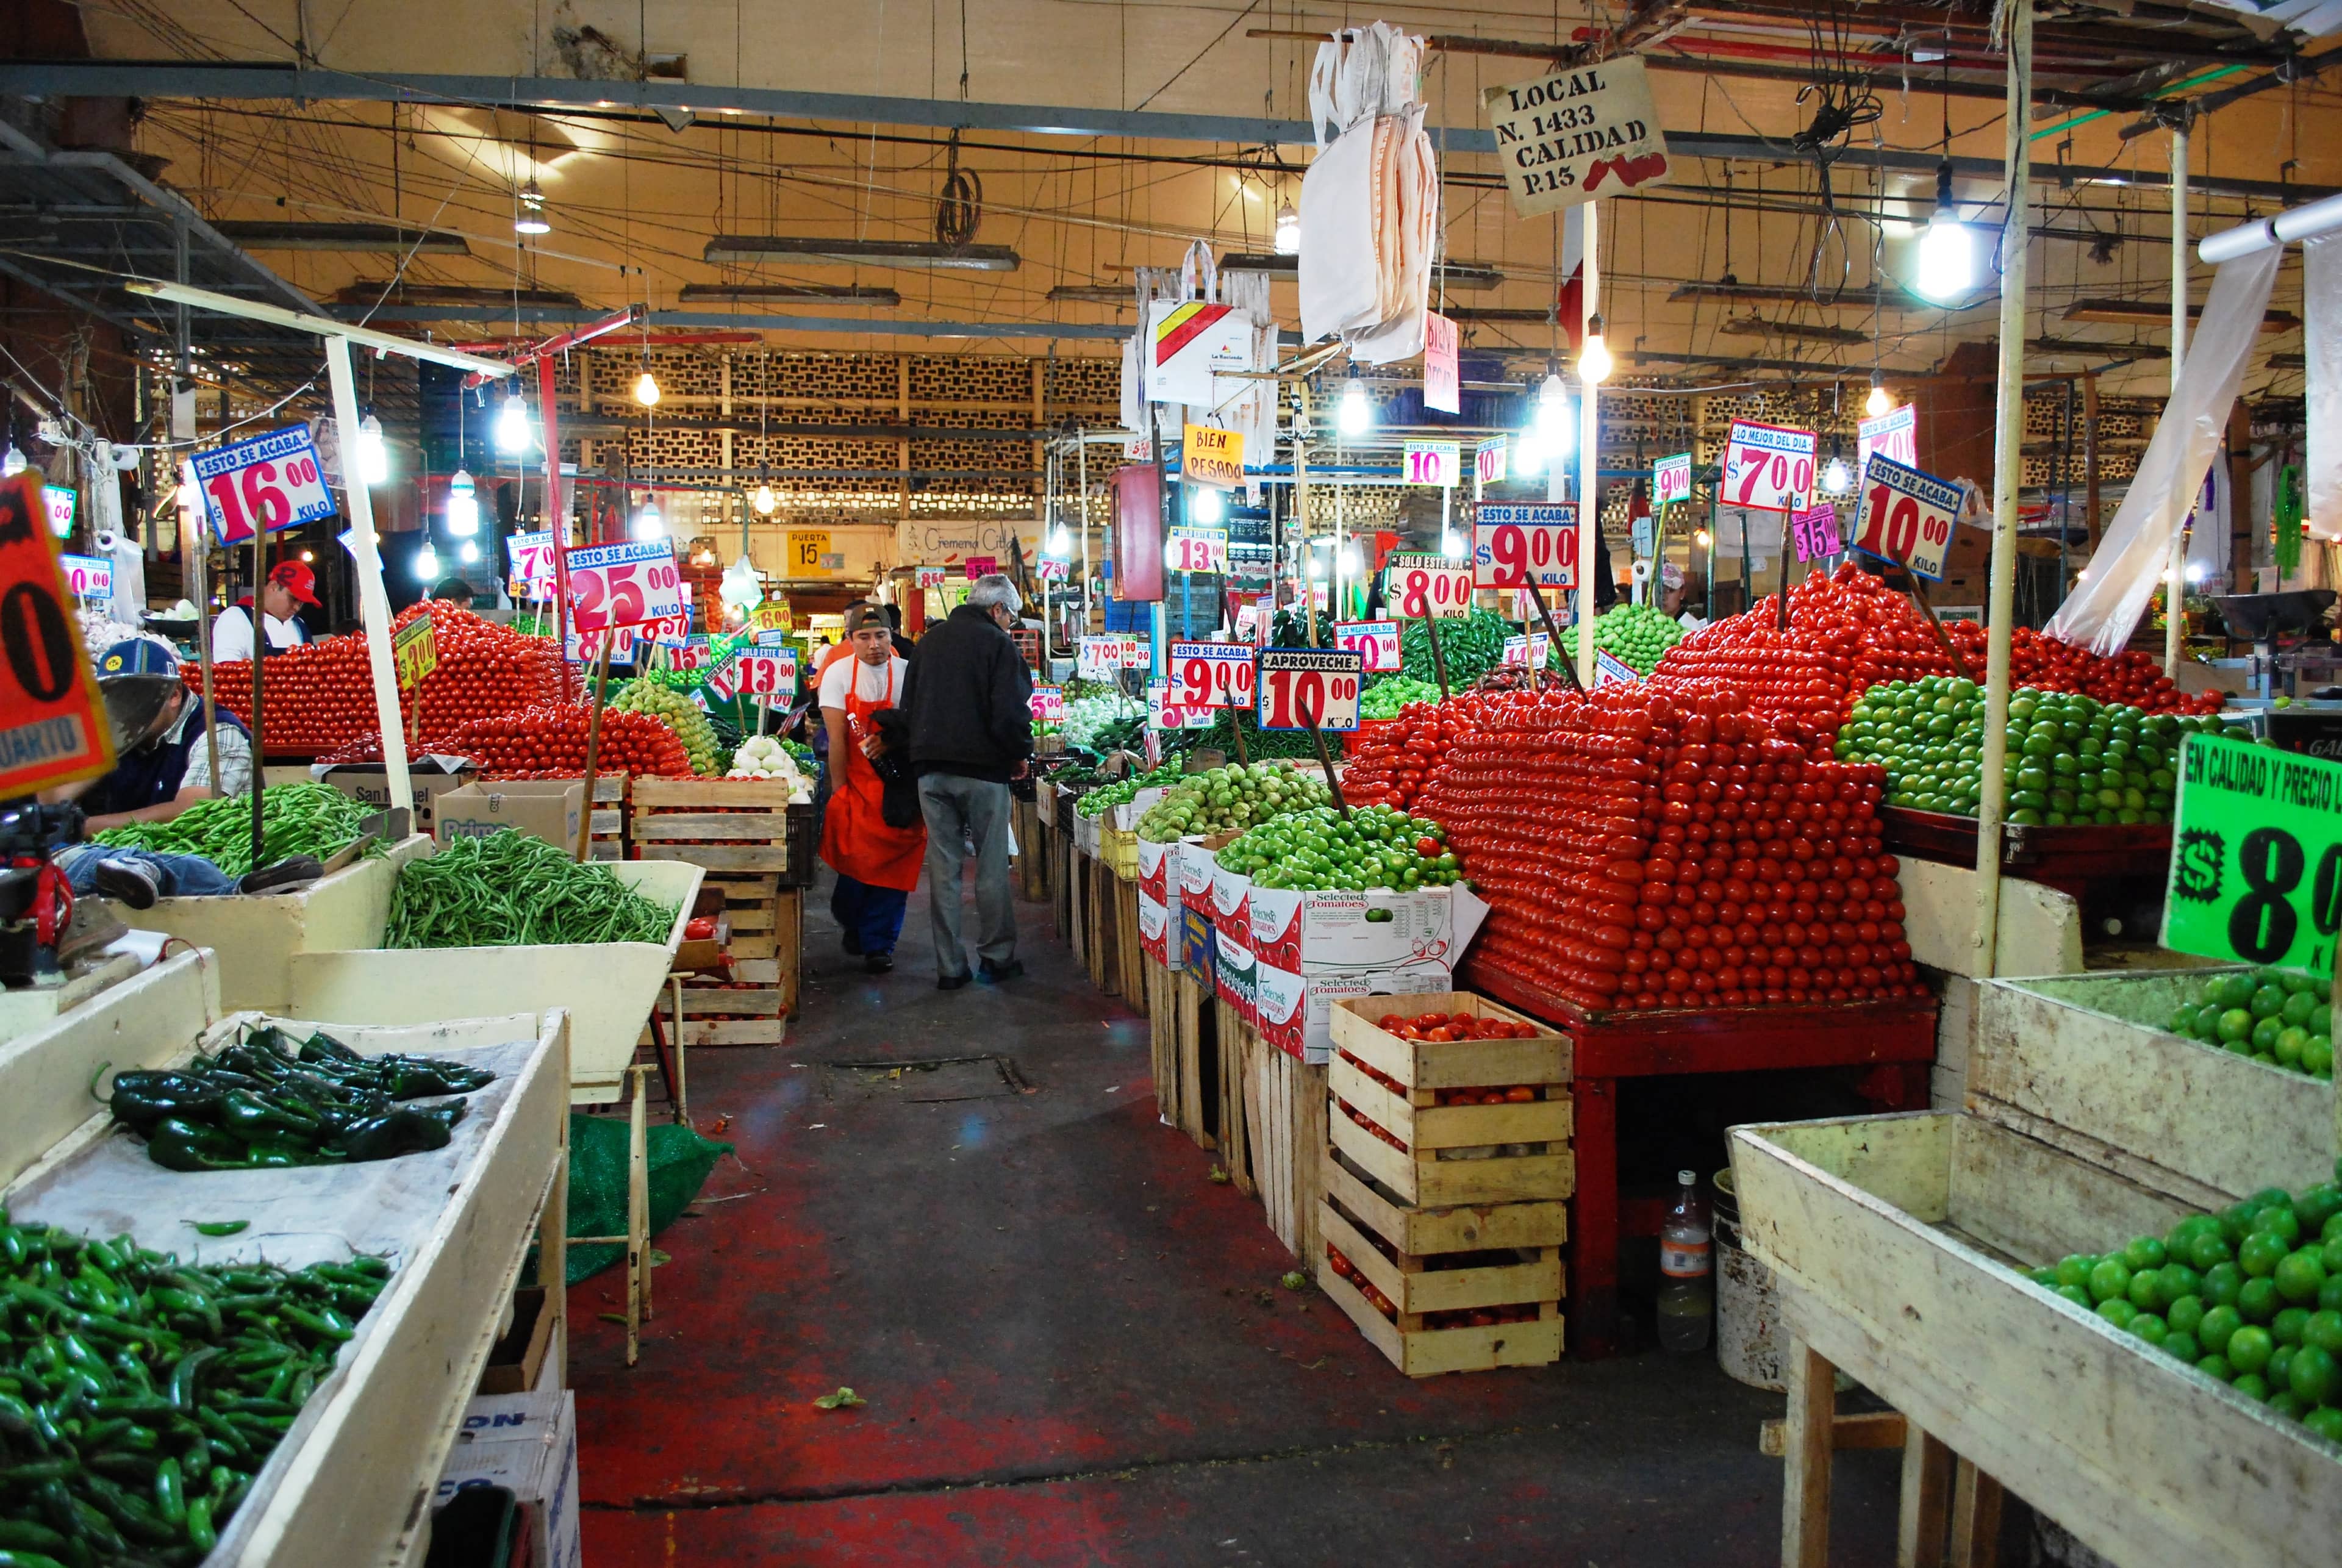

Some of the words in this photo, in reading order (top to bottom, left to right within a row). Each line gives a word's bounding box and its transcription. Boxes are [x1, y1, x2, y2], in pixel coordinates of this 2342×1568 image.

[1508, 71, 1606, 112] LOCAL
[1496, 122, 1524, 145] N.
[1532, 104, 1595, 137] 1433
[1516, 120, 1647, 168] CALIDAD
[1522, 165, 1575, 196] P.15
[1862, 424, 1878, 435] ESTO
[1880, 421, 1886, 430] SE
[1889, 413, 1910, 428] ACABA
[1197, 431, 1227, 449] BIEN
[1737, 429, 1746, 440] LO
[1749, 431, 1773, 443] MEJOR
[1777, 435, 1790, 446] DEL
[1794, 438, 1807, 449] DIA
[205, 454, 237, 473] ESTO
[242, 448, 256, 459] SE
[259, 435, 302, 457] ACABA
[1658, 457, 1686, 469] APROVECHE
[1191, 457, 1241, 479] PESADO
[1409, 451, 1440, 483] 10
[1478, 449, 1494, 482] 10
[1874, 462, 1899, 484] ESTO
[1902, 474, 1916, 490] SE
[1917, 481, 1953, 507] ACABA
[298, 501, 328, 518] KILO
[1778, 496, 1801, 507] KIO
[1483, 509, 1511, 520] ESTO
[1518, 509, 1528, 520] SE
[1533, 509, 1570, 521] ACABA
[925, 528, 978, 551] Cremeria
[573, 550, 603, 565] ESTO
[607, 548, 621, 560] SE
[625, 543, 664, 557] ACABA
[800, 543, 817, 565] 15
[1179, 539, 1209, 570] 13
[1399, 556, 1423, 568] SOLO
[1424, 557, 1446, 569] ESTE
[1449, 558, 1464, 569] DIA
[1913, 554, 1937, 575] KILO
[1541, 573, 1567, 584] KILO
[571, 563, 645, 625] 25
[652, 604, 679, 617] KILO
[1443, 609, 1464, 619] KILO
[742, 648, 757, 657] SOLO
[760, 648, 776, 657] ESTE
[779, 648, 789, 658] DIA
[1177, 646, 1200, 655] ESTO
[1203, 647, 1213, 656] SE
[1216, 648, 1247, 657] ACABA
[1383, 639, 1395, 652] 00
[670, 646, 697, 671] 15
[1269, 656, 1352, 668] APROVECHE
[707, 669, 717, 681] ESTO
[738, 657, 776, 693] 13
[1154, 678, 1169, 687] SOL
[1223, 696, 1244, 705] KLO
[2185, 742, 2205, 784] EN
[2208, 746, 2266, 797] CALIDAD
[2271, 759, 2281, 800] Y
[2282, 762, 2332, 812] PRECIO
[356, 786, 381, 803] San
